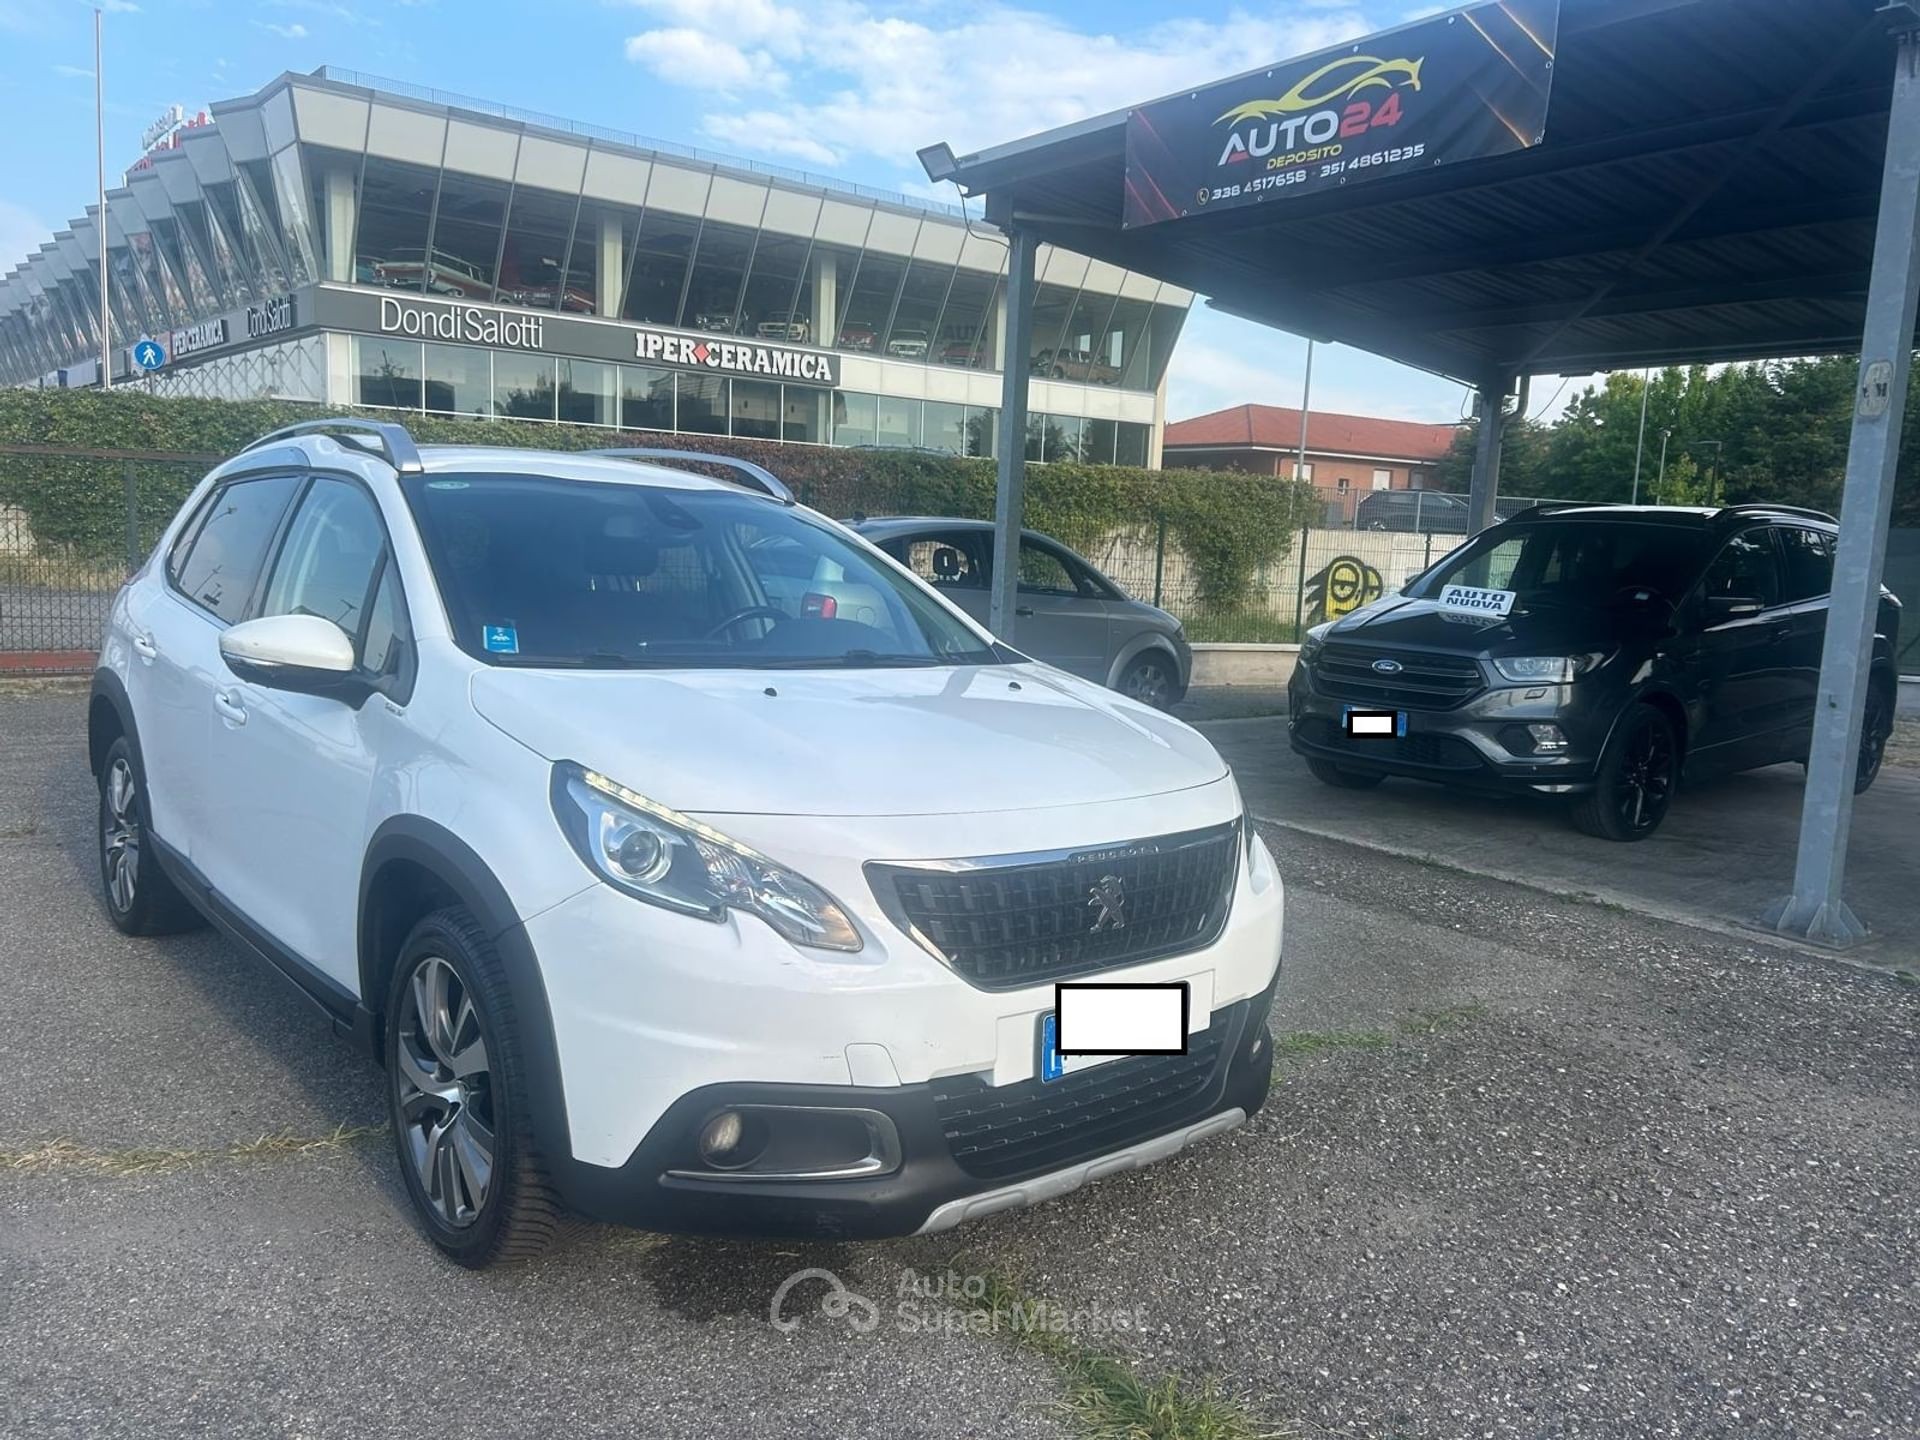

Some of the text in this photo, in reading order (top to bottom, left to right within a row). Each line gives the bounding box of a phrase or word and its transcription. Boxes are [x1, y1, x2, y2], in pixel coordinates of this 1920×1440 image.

[1218, 92, 1403, 166] AUTO24
[1266, 144, 1342, 170] DEPOSITO
[1211, 144, 1425, 200] 338 4517658 351 4861235
[1446, 597, 1502, 610] NUOVA
[1449, 589, 1506, 602] AUTO
